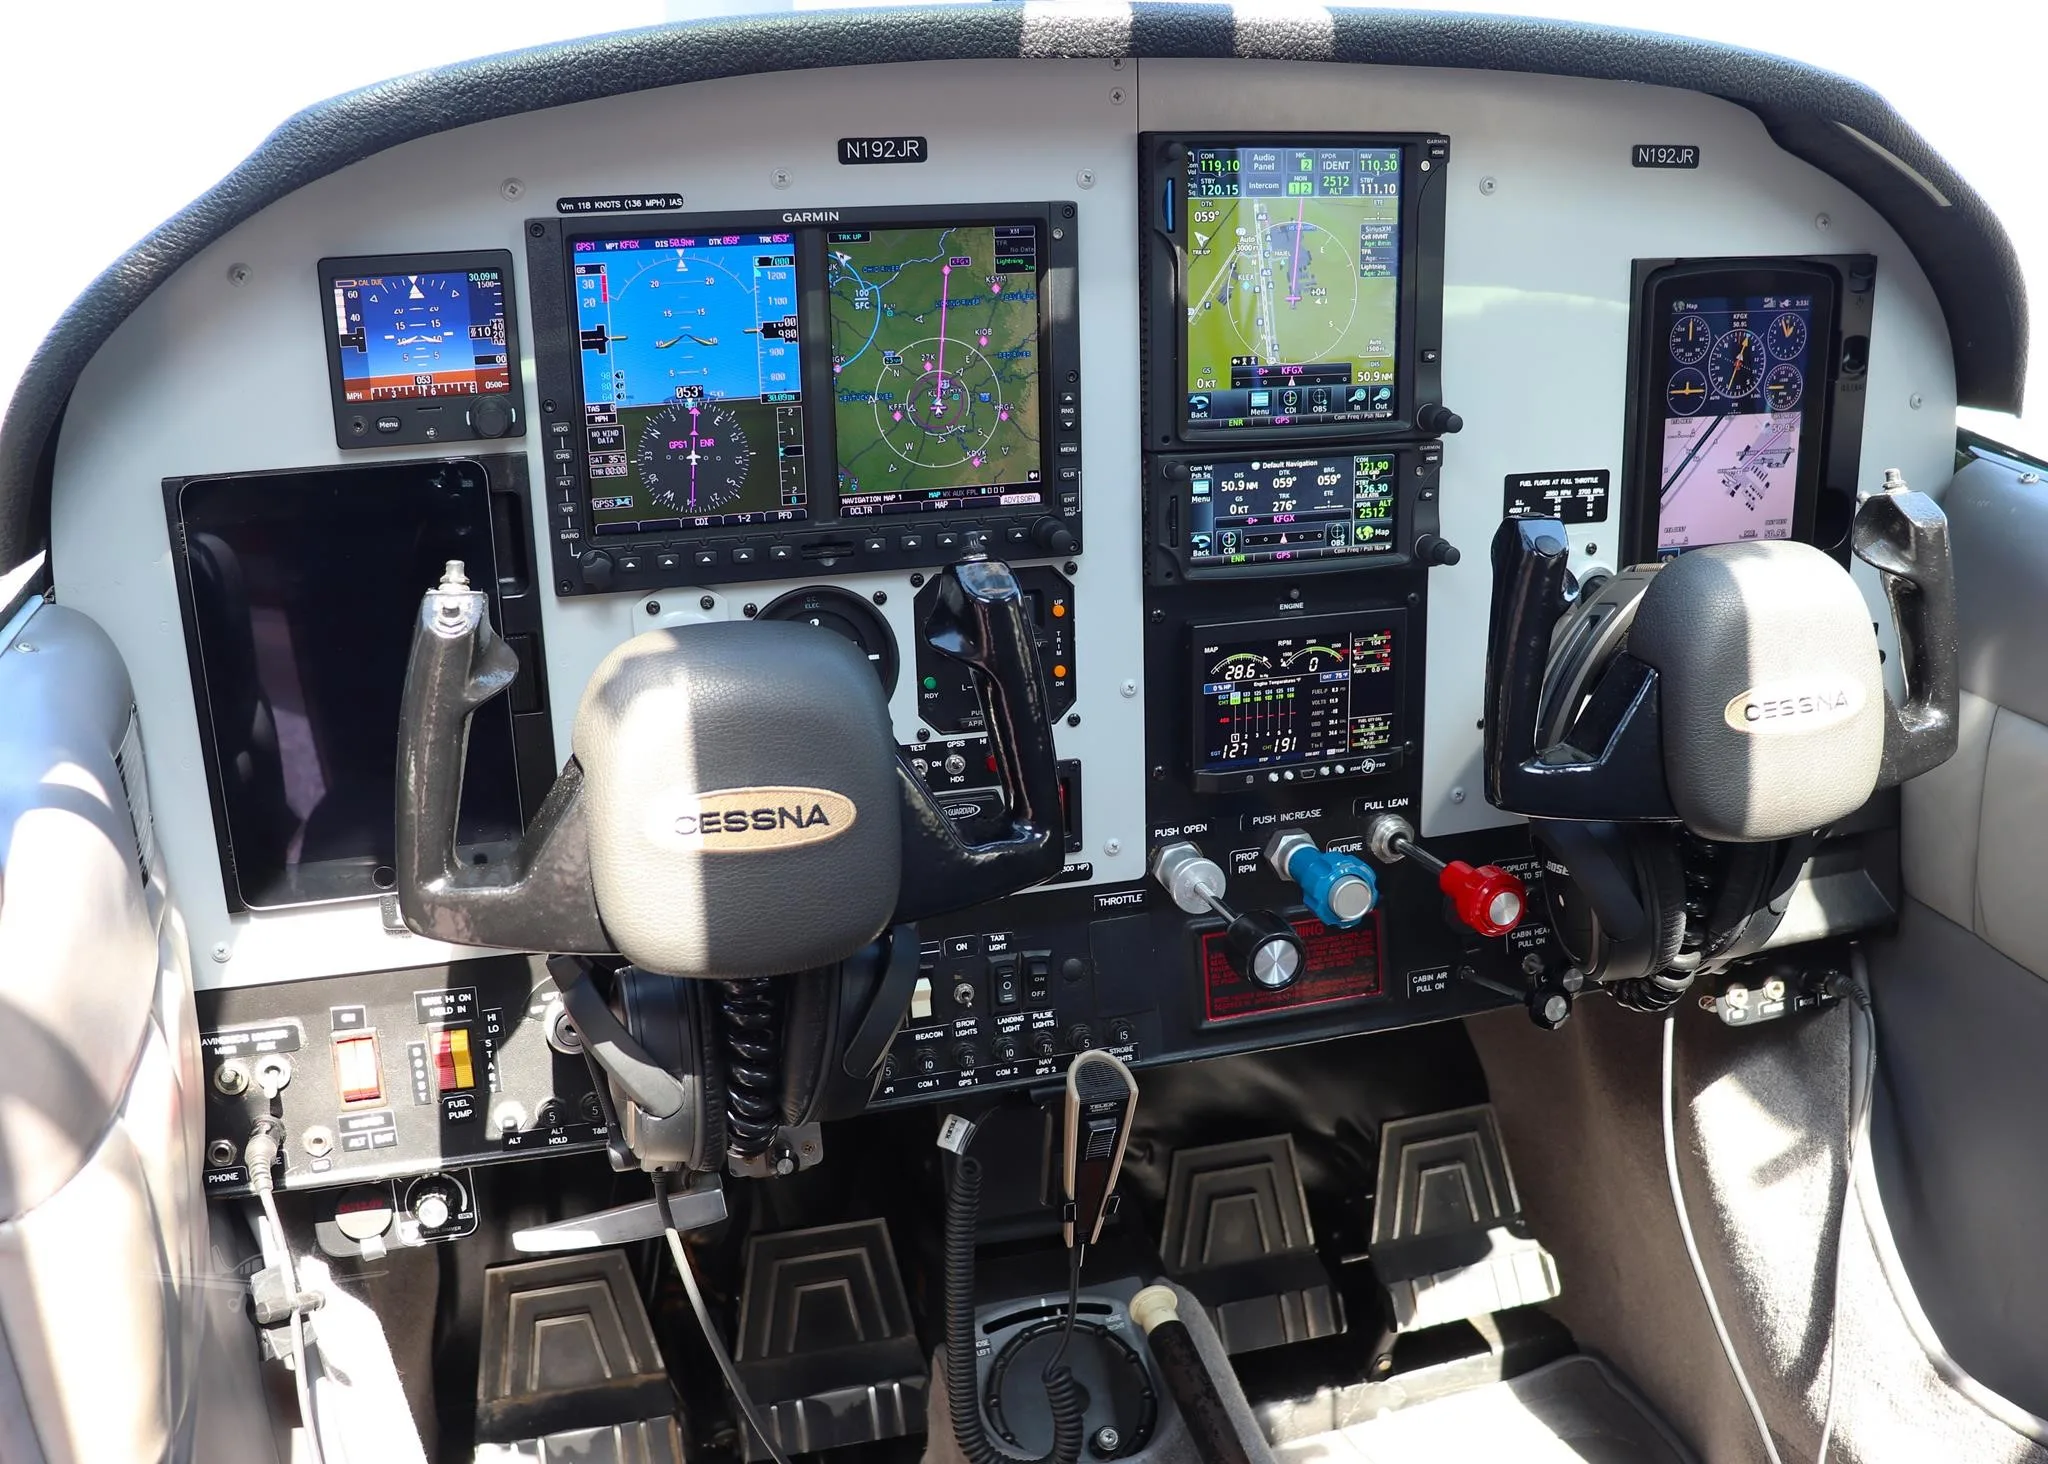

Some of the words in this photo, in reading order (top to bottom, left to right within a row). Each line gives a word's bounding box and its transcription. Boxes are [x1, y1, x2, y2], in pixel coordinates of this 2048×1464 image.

[847, 140, 919, 159] N192JR
[1254, 153, 1275, 161] Audio
[1639, 148, 1694, 164] N192JR
[1200, 160, 1239, 171] 119.10
[1323, 161, 1349, 170] IDENT
[1359, 160, 1397, 171] 110.30
[1323, 175, 1349, 186] 2512
[1201, 185, 1239, 195] 120.15
[1329, 187, 1343, 195] ALT
[1360, 183, 1396, 194] 111.10
[561, 202, 574, 211] Vm
[594, 200, 621, 209] KNOTS
[624, 199, 642, 209] (136
[645, 198, 666, 208] MPH)
[669, 198, 683, 206] IAS
[782, 212, 839, 222] GARMIN
[576, 242, 595, 251] GPS1
[605, 242, 618, 250] WPT
[619, 240, 640, 249] KFGX
[655, 240, 668, 248] DIS
[709, 238, 722, 246] DTK
[1281, 366, 1303, 375] KFGX
[416, 376, 431, 385] 053
[346, 392, 363, 400] MPH
[1284, 406, 1297, 414] CDI
[1313, 405, 1327, 413] OBS
[1375, 402, 1387, 410] Out
[1191, 411, 1208, 419] Back
[1250, 408, 1269, 416] Menu
[1228, 418, 1243, 427] ENR
[1275, 416, 1290, 424] GPS
[553, 425, 568, 433] HDG
[669, 440, 687, 449] GPS1
[700, 439, 715, 448] ENR
[590, 456, 604, 464] SAT
[1262, 460, 1283, 470] Default
[1285, 459, 1318, 468] Navigation
[1359, 461, 1389, 471] 121.90
[1221, 480, 1244, 491] 50.9
[1359, 483, 1388, 493] 126.30
[842, 494, 881, 504] NAVIGATION
[883, 493, 896, 501] MAP
[928, 491, 941, 499] MAP
[1003, 494, 1037, 504] ADVISORY
[1191, 495, 1210, 503] Menu
[594, 499, 614, 509] GPSS
[934, 500, 948, 509] MAP
[850, 505, 873, 516] DCLTR
[1359, 508, 1385, 518] 2512
[778, 511, 793, 520] PFD
[1273, 514, 1295, 524] KFGX
[694, 518, 709, 527] CDI
[560, 532, 579, 540] BARO
[1375, 528, 1390, 537] Map
[1331, 539, 1345, 547] OBS
[1192, 549, 1210, 557] Back
[1223, 547, 1236, 555] CDI
[1276, 551, 1291, 560] GPS
[1230, 554, 1246, 563] ENR
[1279, 602, 1304, 611] ENGINE
[1277, 639, 1292, 647] RPM
[1225, 663, 1256, 680] 28.6
[1744, 691, 1848, 722] CESSNA
[910, 744, 927, 752] TEST
[947, 740, 965, 748] GPSS
[1274, 737, 1297, 753] 191
[1222, 743, 1249, 759] 127
[931, 760, 942, 768] ON
[1364, 801, 1384, 811] PULL
[1386, 798, 1409, 808] LEAN
[948, 806, 975, 816] GUARDIAN
[675, 804, 830, 835] CESSNA
[1252, 814, 1278, 825] PUSH
[1280, 809, 1322, 822] INCREASE
[1154, 826, 1181, 838] PUSH
[1183, 823, 1208, 835] OPEN
[1235, 852, 1259, 862] PROP
[1238, 863, 1257, 873] RPM
[1099, 893, 1143, 907] THROTTLE
[990, 934, 1005, 942] TAXI
[1511, 930, 1532, 940] CABIN
[956, 942, 968, 951] ON
[988, 942, 1007, 951] LIGHT
[1518, 939, 1533, 948] PULL
[1536, 937, 1546, 945] ON
[1412, 974, 1434, 984] CABIN
[1437, 971, 1448, 980] AIR
[1416, 984, 1433, 993] PULL
[1435, 982, 1445, 991] ON
[459, 993, 472, 1002] ON
[457, 1005, 467, 1014] IN
[997, 1015, 1025, 1025] LANDING
[1033, 1011, 1053, 1020] PULSE
[956, 1019, 976, 1028] BROW
[1032, 1019, 1055, 1029] LIGHTS
[488, 1024, 499, 1033] LO
[955, 1027, 978, 1037] LIGHTS
[1002, 1024, 1020, 1033] LIGHT
[915, 1030, 944, 1041] BEACON
[1119, 1030, 1128, 1041] 15
[1083, 1039, 1090, 1048] 5
[1005, 1048, 1014, 1058] 10
[925, 1059, 934, 1069] 10
[1039, 1058, 1053, 1066] NAV
[961, 1069, 975, 1078] NAV
[996, 1067, 1012, 1077] COM
[1036, 1066, 1050, 1075] GPS
[917, 1079, 934, 1089] COM
[958, 1078, 973, 1087] GPS
[448, 1100, 470, 1109] FUEL
[448, 1109, 473, 1120] PUMP
[551, 1127, 564, 1135] ALT
[509, 1137, 522, 1145] ALT
[548, 1136, 568, 1145] HOLD
[208, 1172, 240, 1183] PHONE
